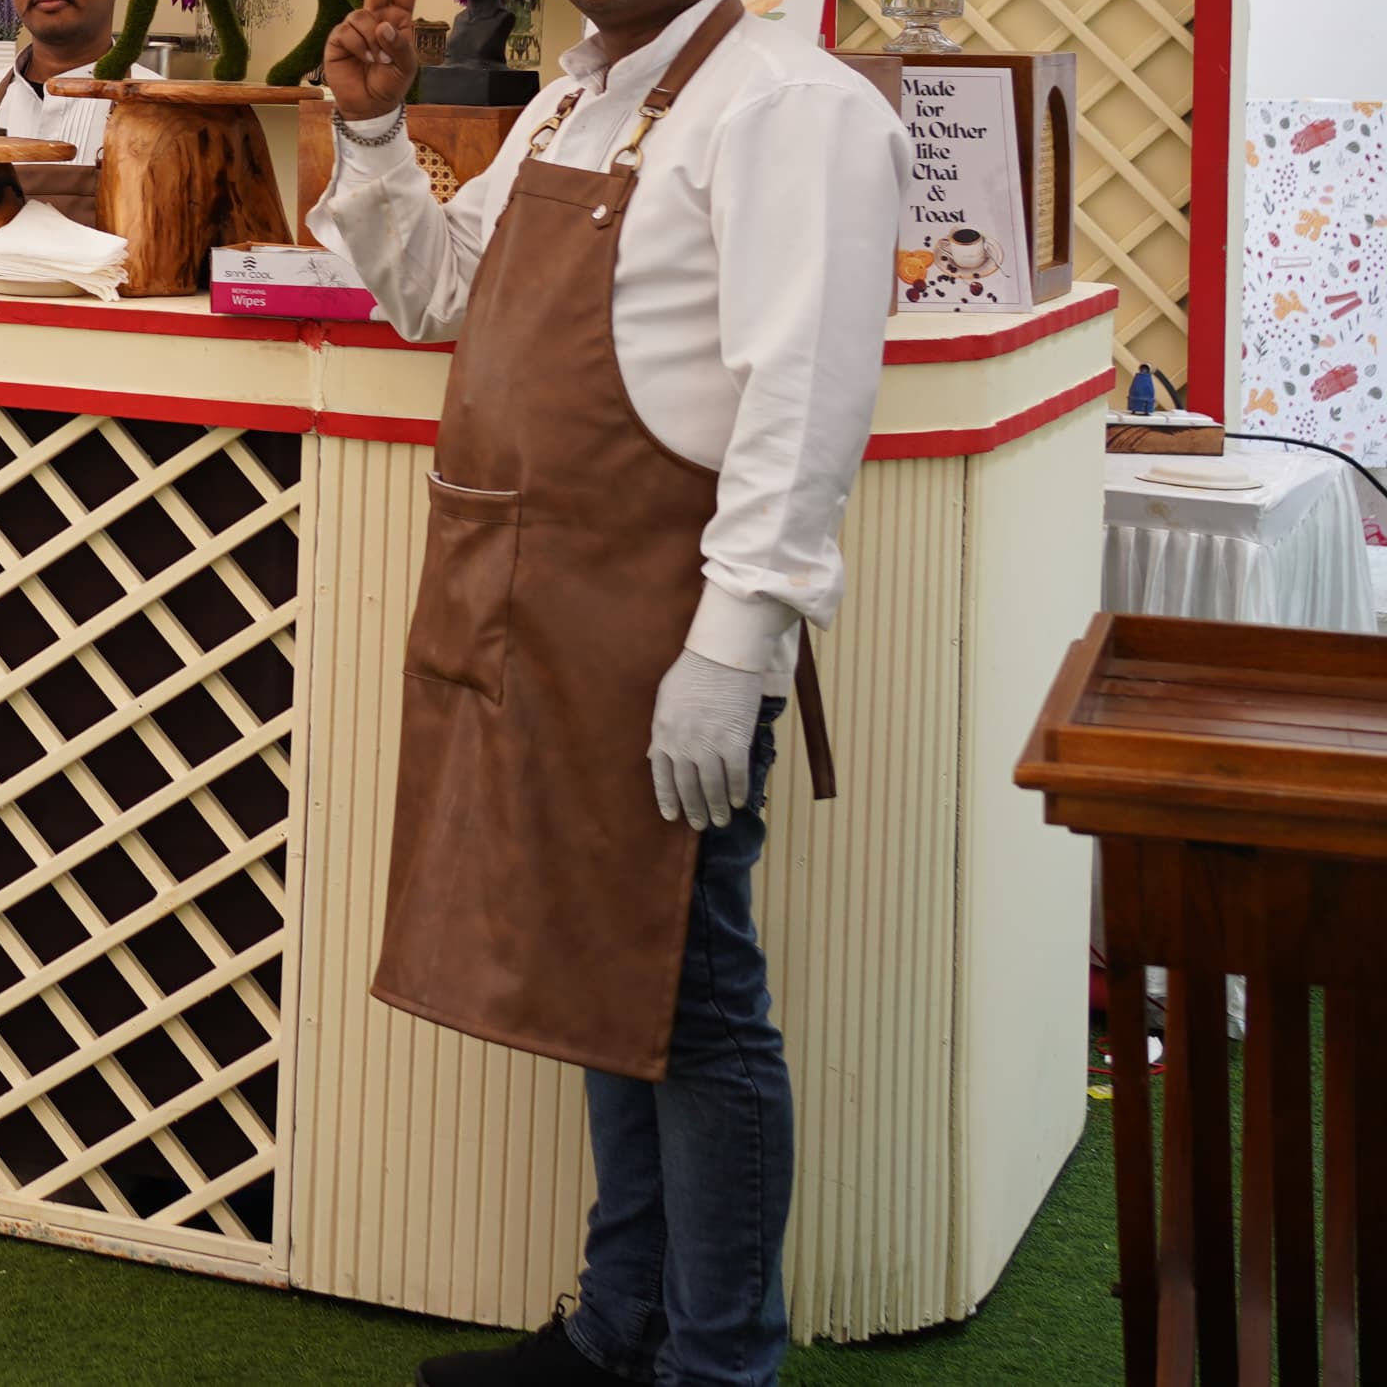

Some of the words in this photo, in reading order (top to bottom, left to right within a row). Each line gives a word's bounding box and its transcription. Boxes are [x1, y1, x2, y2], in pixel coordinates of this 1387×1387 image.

[902, 79, 956, 96] Made
[916, 100, 944, 117] for
[929, 121, 987, 139] Other
[916, 143, 951, 160] like
[912, 163, 959, 181] Chai
[927, 184, 946, 202] &
[910, 205, 967, 223] Toast
[231, 294, 266, 308] Wipes
